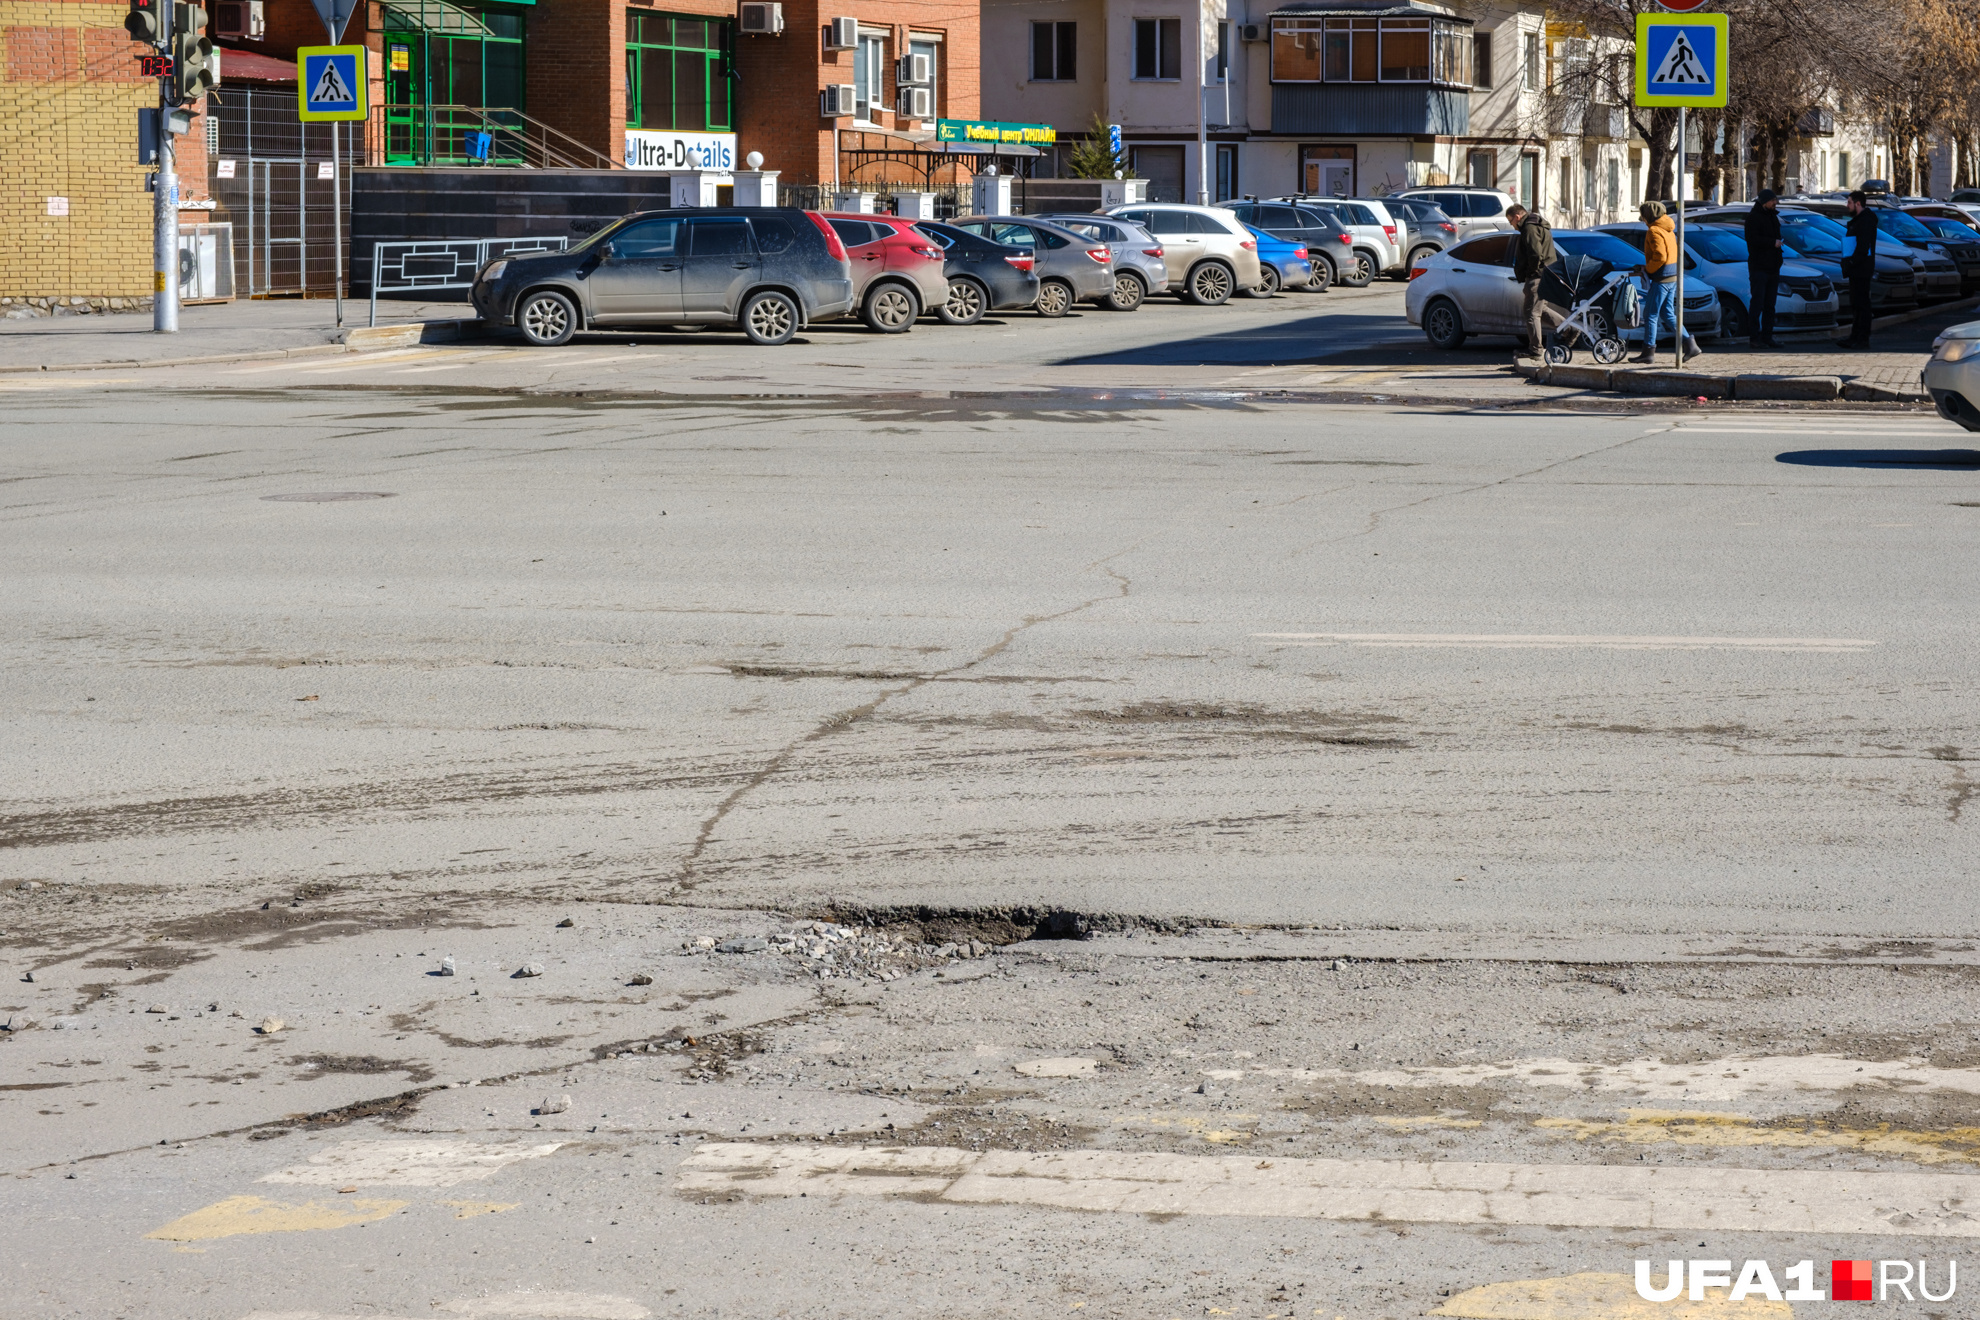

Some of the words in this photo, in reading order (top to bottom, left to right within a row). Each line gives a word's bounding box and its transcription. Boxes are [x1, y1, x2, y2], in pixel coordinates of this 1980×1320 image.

[143, 57, 174, 77] 0:32
[966, 125, 999, 140] Учебный
[1001, 130, 1022, 144] центр
[1024, 126, 1056, 142] ОНЛАЙН
[625, 137, 731, 168] Ultra-Dtails
